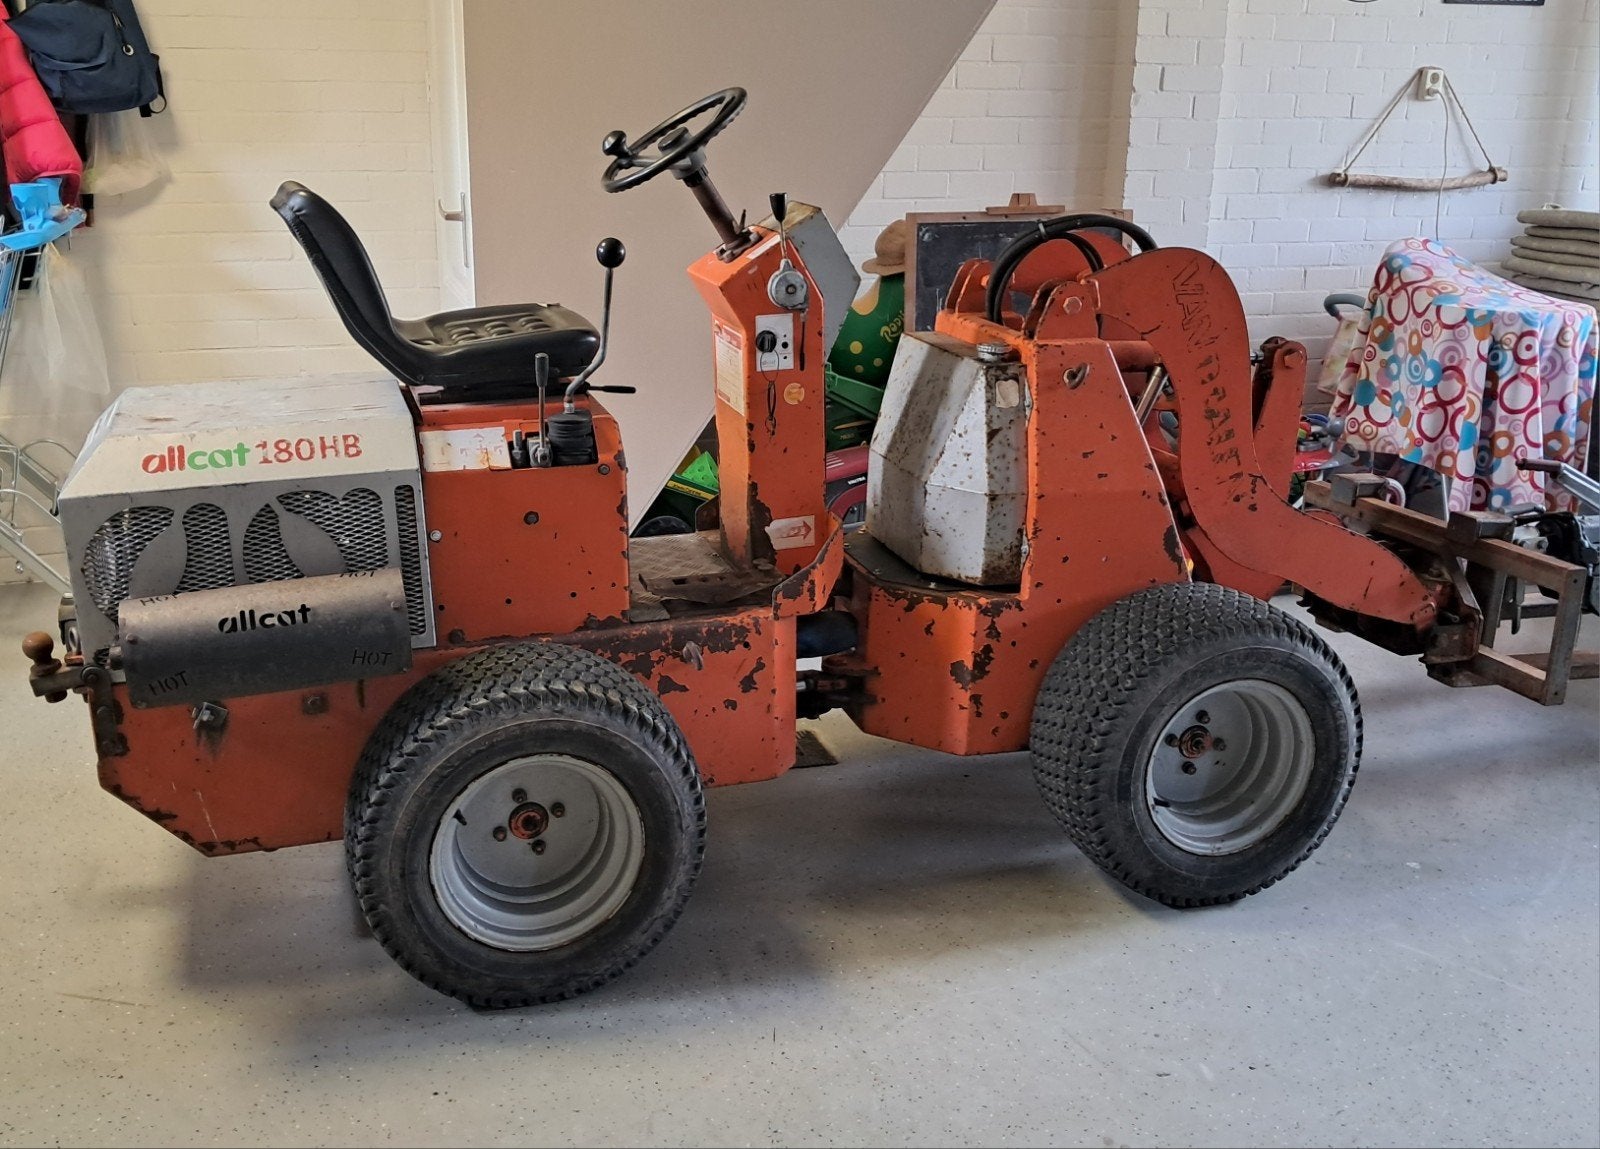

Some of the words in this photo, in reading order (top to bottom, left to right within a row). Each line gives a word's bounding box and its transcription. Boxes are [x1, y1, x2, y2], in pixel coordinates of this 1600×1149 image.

[141, 442, 250, 473] allcat
[218, 604, 311, 634] allcat
[351, 650, 393, 666] HOT
[148, 670, 190, 696] HOT
